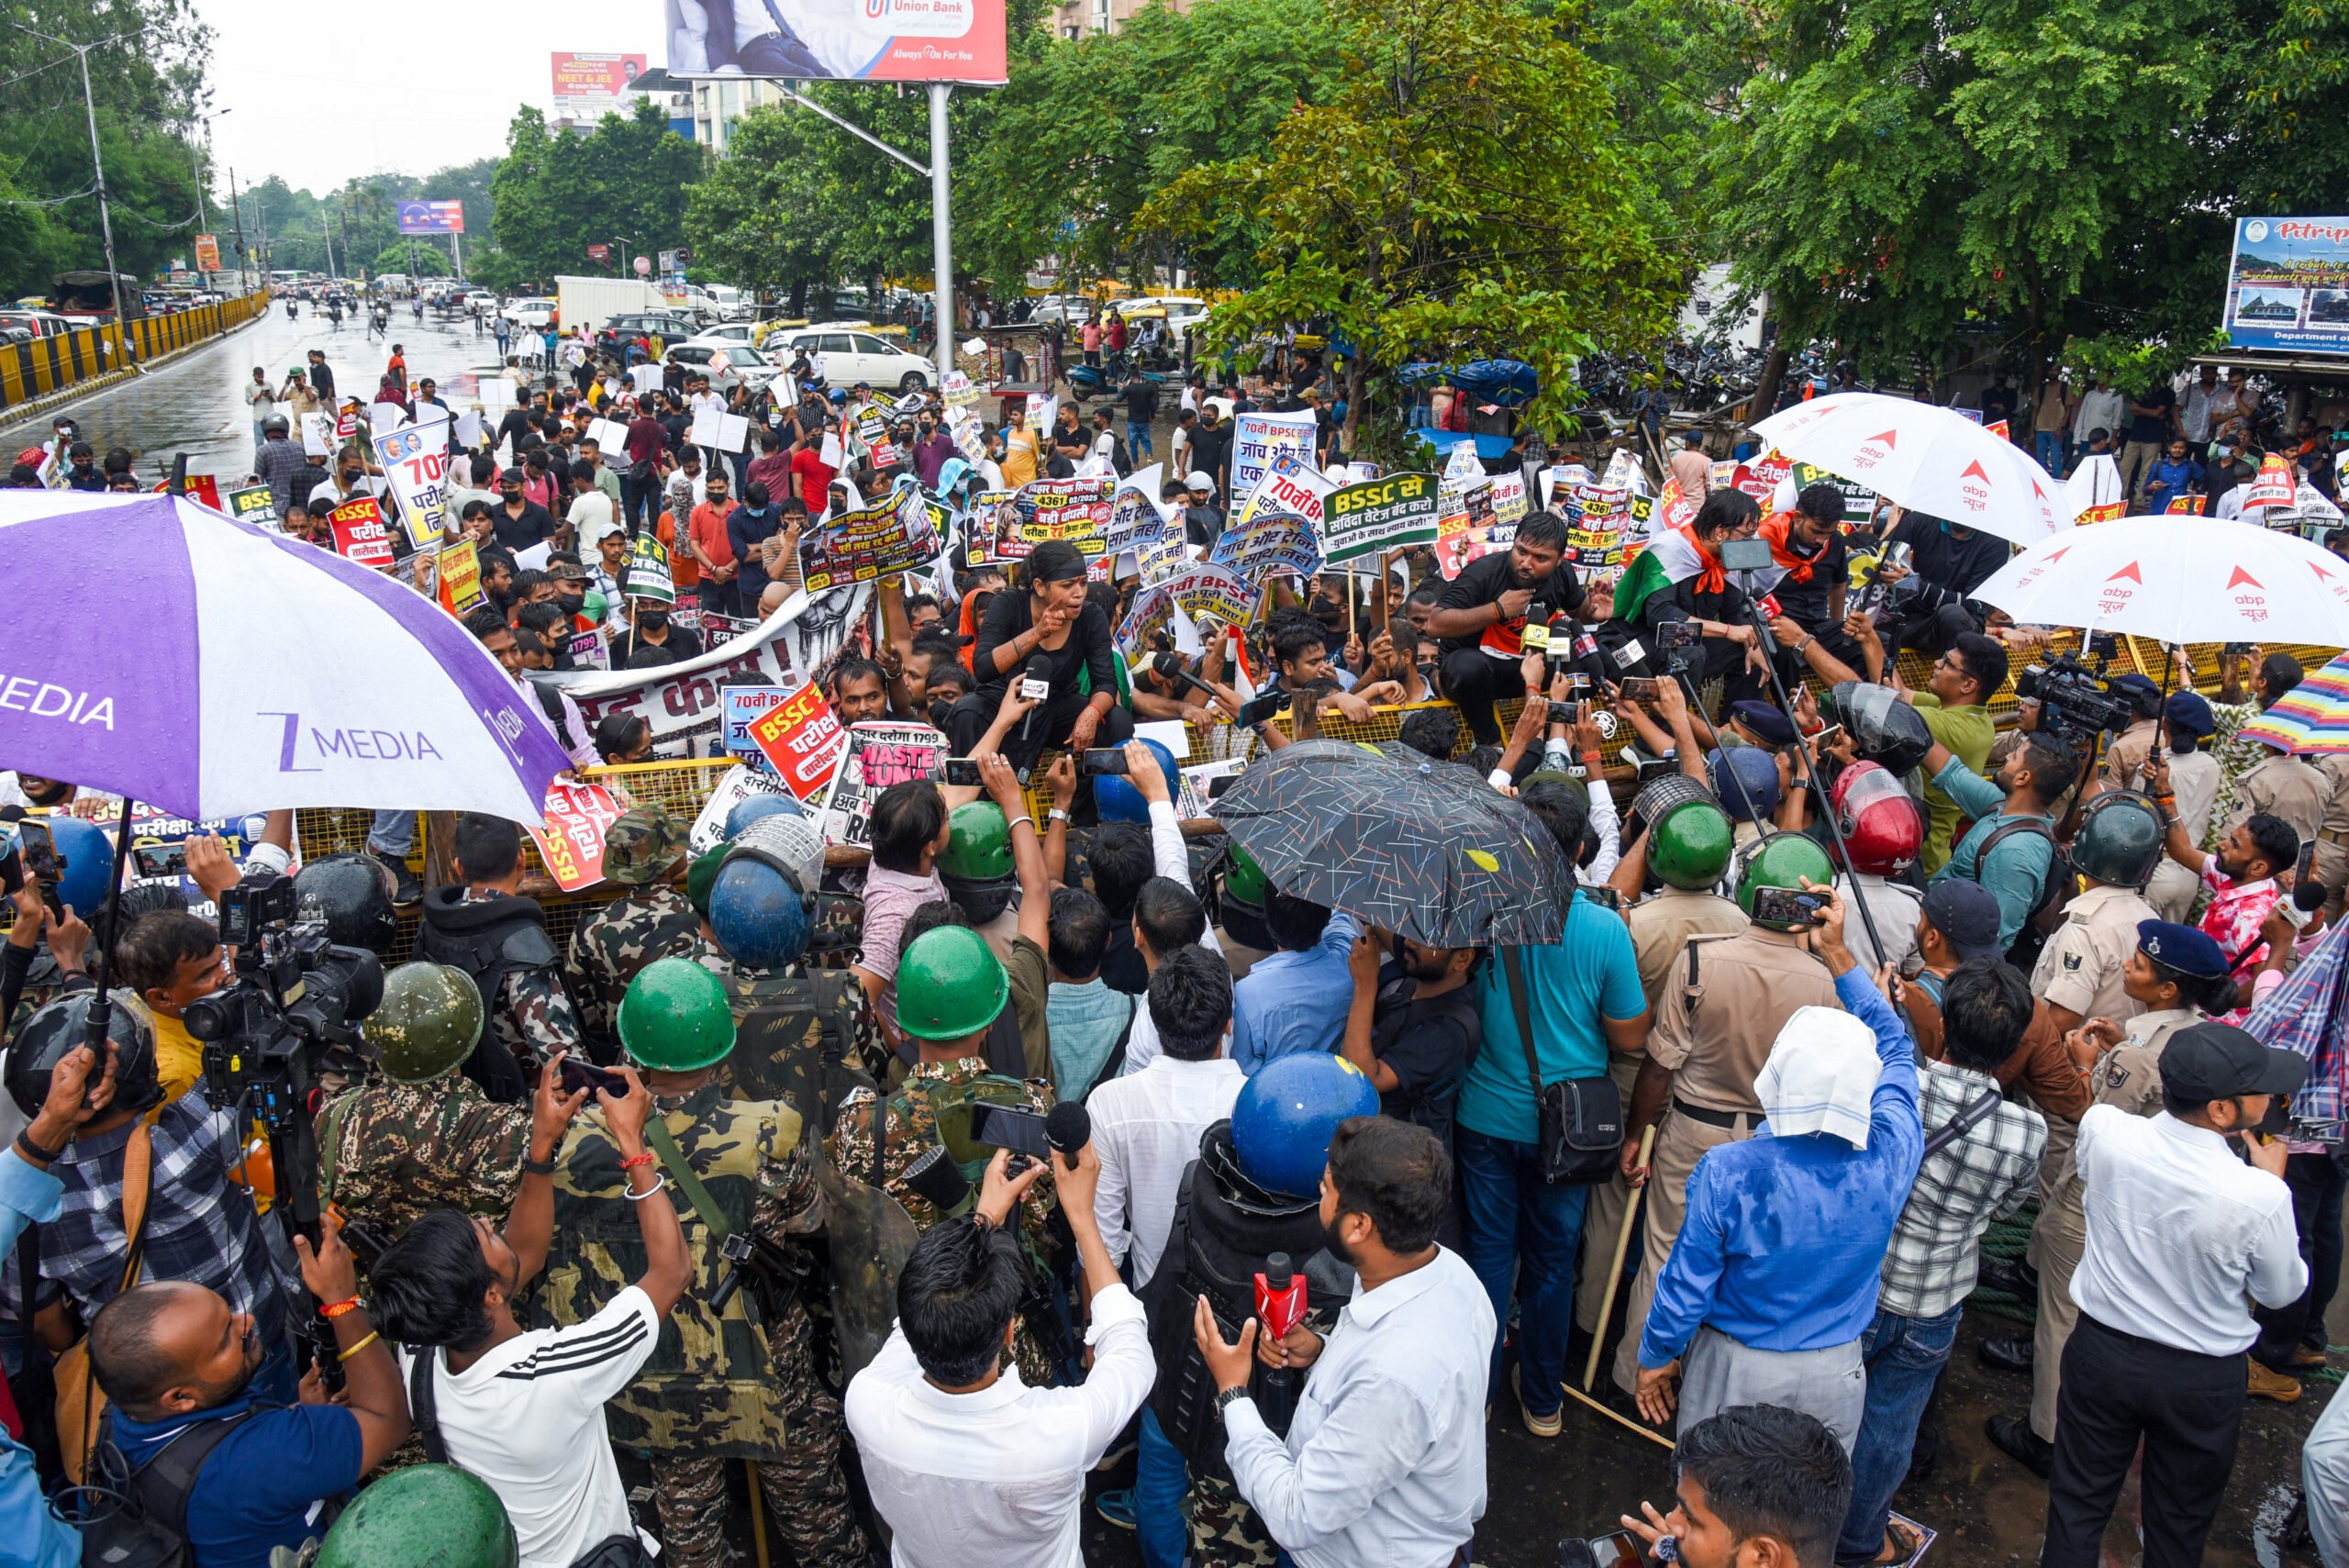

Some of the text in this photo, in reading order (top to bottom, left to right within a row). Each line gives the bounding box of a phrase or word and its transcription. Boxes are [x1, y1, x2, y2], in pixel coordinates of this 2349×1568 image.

[933, 1, 963, 13] Bank
[893, 50, 973, 61] Always On For You
[557, 74, 613, 83] NEET & JEE
[2283, 259, 2343, 269] A tribute to
[2255, 272, 2346, 284] connects you with
[2275, 331, 2337, 341] Department
[873, 392, 894, 406] BSSC
[1244, 422, 1296, 438] 70वीं BPSC
[1240, 439, 1268, 459] जांच
[1860, 445, 1885, 459] abp
[1853, 455, 1876, 469] न्यूज़
[1240, 464, 1264, 482] एक
[1714, 475, 1730, 485] जांच
[2275, 472, 2287, 485] की
[1028, 480, 1099, 495] बिहार चालक सिपाही
[1270, 475, 1316, 511] 70वीं
[1335, 474, 1426, 514] BSSC से
[1578, 486, 1599, 501] बिहार
[1845, 484, 1857, 495] बंद
[1963, 484, 1987, 498] abp
[2259, 489, 2274, 498] जारी
[1038, 495, 1098, 506] 4361 02/2025
[1448, 493, 1464, 504] BPSC
[1963, 497, 1987, 511] न्यूज़
[334, 503, 376, 521] BSSC
[1038, 505, 1089, 526] बड़ी धांधली
[1112, 502, 1156, 526] और ट्रेनि
[1329, 496, 1433, 533] संविदा वेटेज बंद करो
[1586, 504, 1609, 514] 4361
[846, 512, 866, 526] पुलिस
[926, 506, 943, 531] से
[1583, 517, 1602, 533] बड़ी
[349, 521, 386, 540] परीक्ष
[1025, 522, 1093, 537] परीक्षा रद्द किया जाए
[1108, 520, 1163, 547] साथ नहीं
[1229, 517, 1306, 538] 70वीं BPSC रद्द
[1358, 521, 1406, 539] के साथ न्याय
[1439, 517, 1468, 537] BSSC
[652, 540, 663, 563] से
[838, 542, 852, 555] पूरी
[853, 539, 870, 550] तरह
[873, 538, 883, 548] रद्द
[884, 533, 900, 544] करो
[1164, 540, 1184, 558] नहीं
[1218, 530, 1282, 558] जांच और
[810, 558, 826, 567] CBSE
[1241, 547, 1316, 569] साथ नहीं
[879, 560, 915, 574] TRANSPARENCY
[1200, 576, 1252, 605] BPSC
[2103, 587, 2132, 598] abp
[1181, 588, 1249, 613] को पूरी तरह
[1184, 598, 1214, 609] किया
[2098, 599, 2127, 614] न्यूज़
[2234, 595, 2265, 606] abp
[2239, 608, 2269, 623] न्यूज़
[573, 635, 596, 654] 1799
[713, 630, 731, 644] हम
[0, 673, 114, 731] EDIA
[734, 692, 768, 708] 70वीं
[759, 695, 815, 743] BSSC
[484, 705, 527, 766] Z MEDIA
[787, 712, 840, 755] परीक्ष
[879, 729, 939, 743] दरोगा 1799
[257, 712, 445, 773] Z MEDIA
[801, 745, 836, 778] तारीख
[863, 764, 927, 786] GUNA
[835, 793, 860, 809] अब
[132, 818, 195, 837] परीक्षा
[540, 825, 580, 882] BSSC
